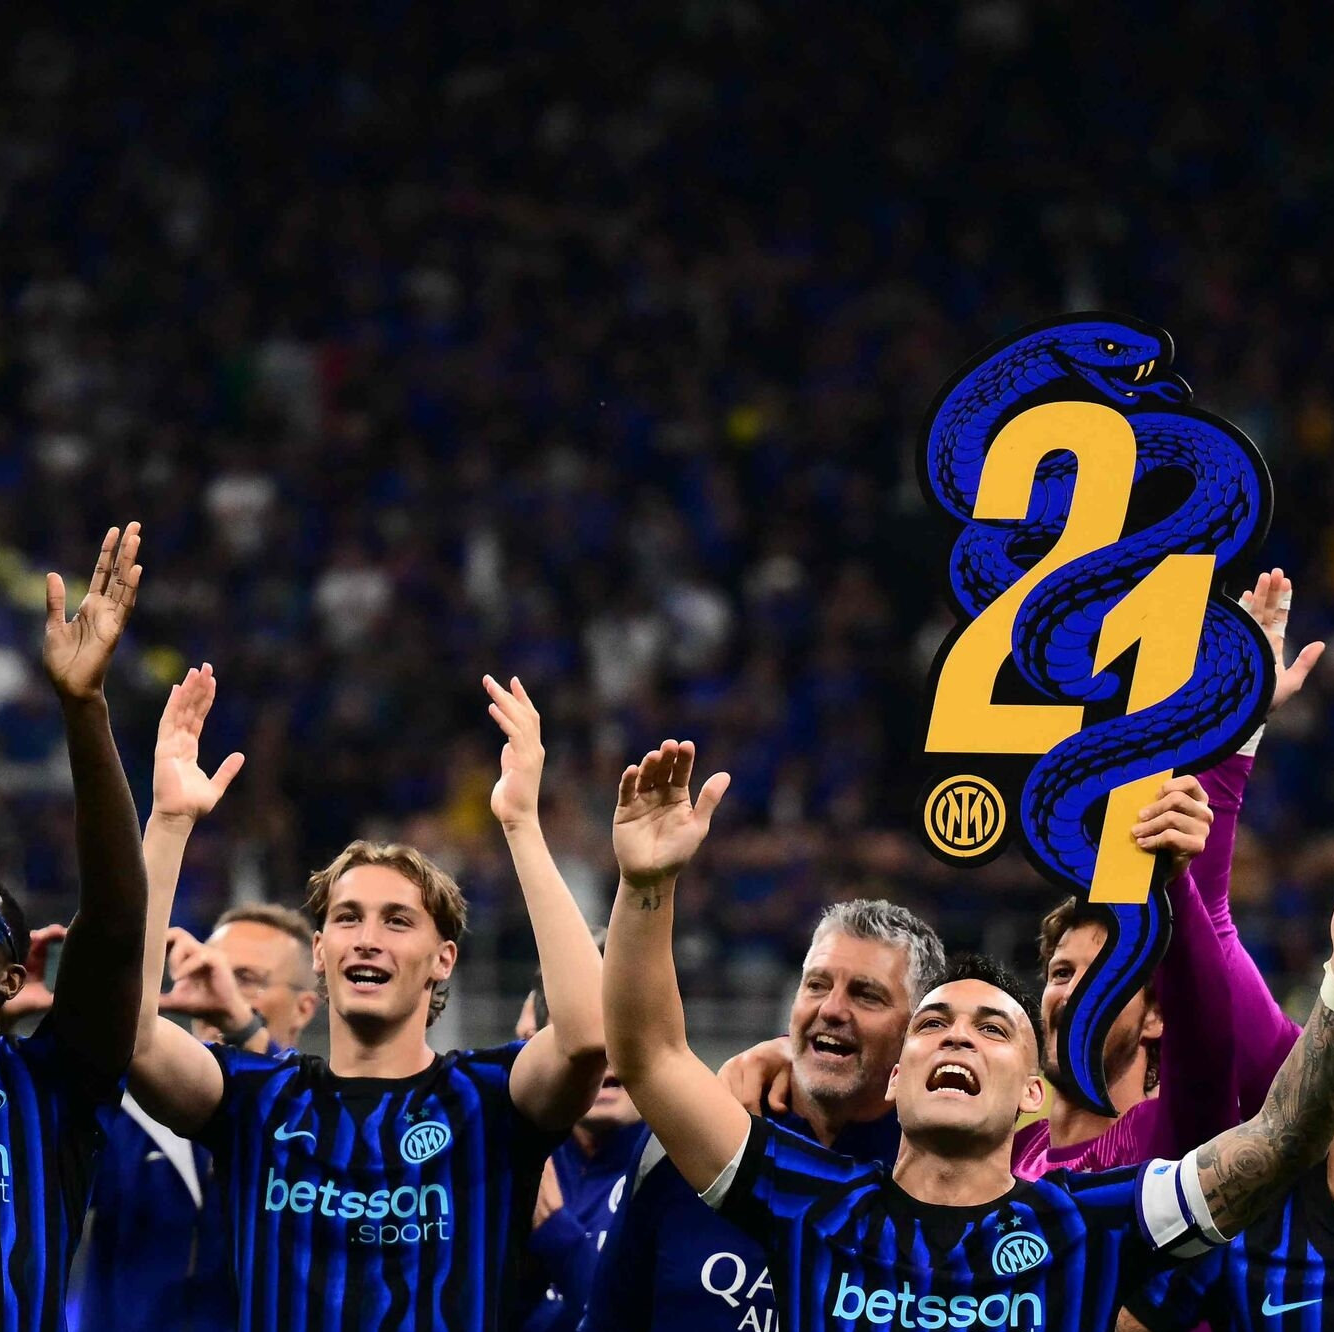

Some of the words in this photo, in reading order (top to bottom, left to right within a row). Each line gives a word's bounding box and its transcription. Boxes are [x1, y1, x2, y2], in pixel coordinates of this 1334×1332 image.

[925, 401, 1216, 904] 21
[265, 1168, 450, 1219] betsson
[350, 1219, 451, 1244] .sport
[832, 1274, 1042, 1328] betsson
